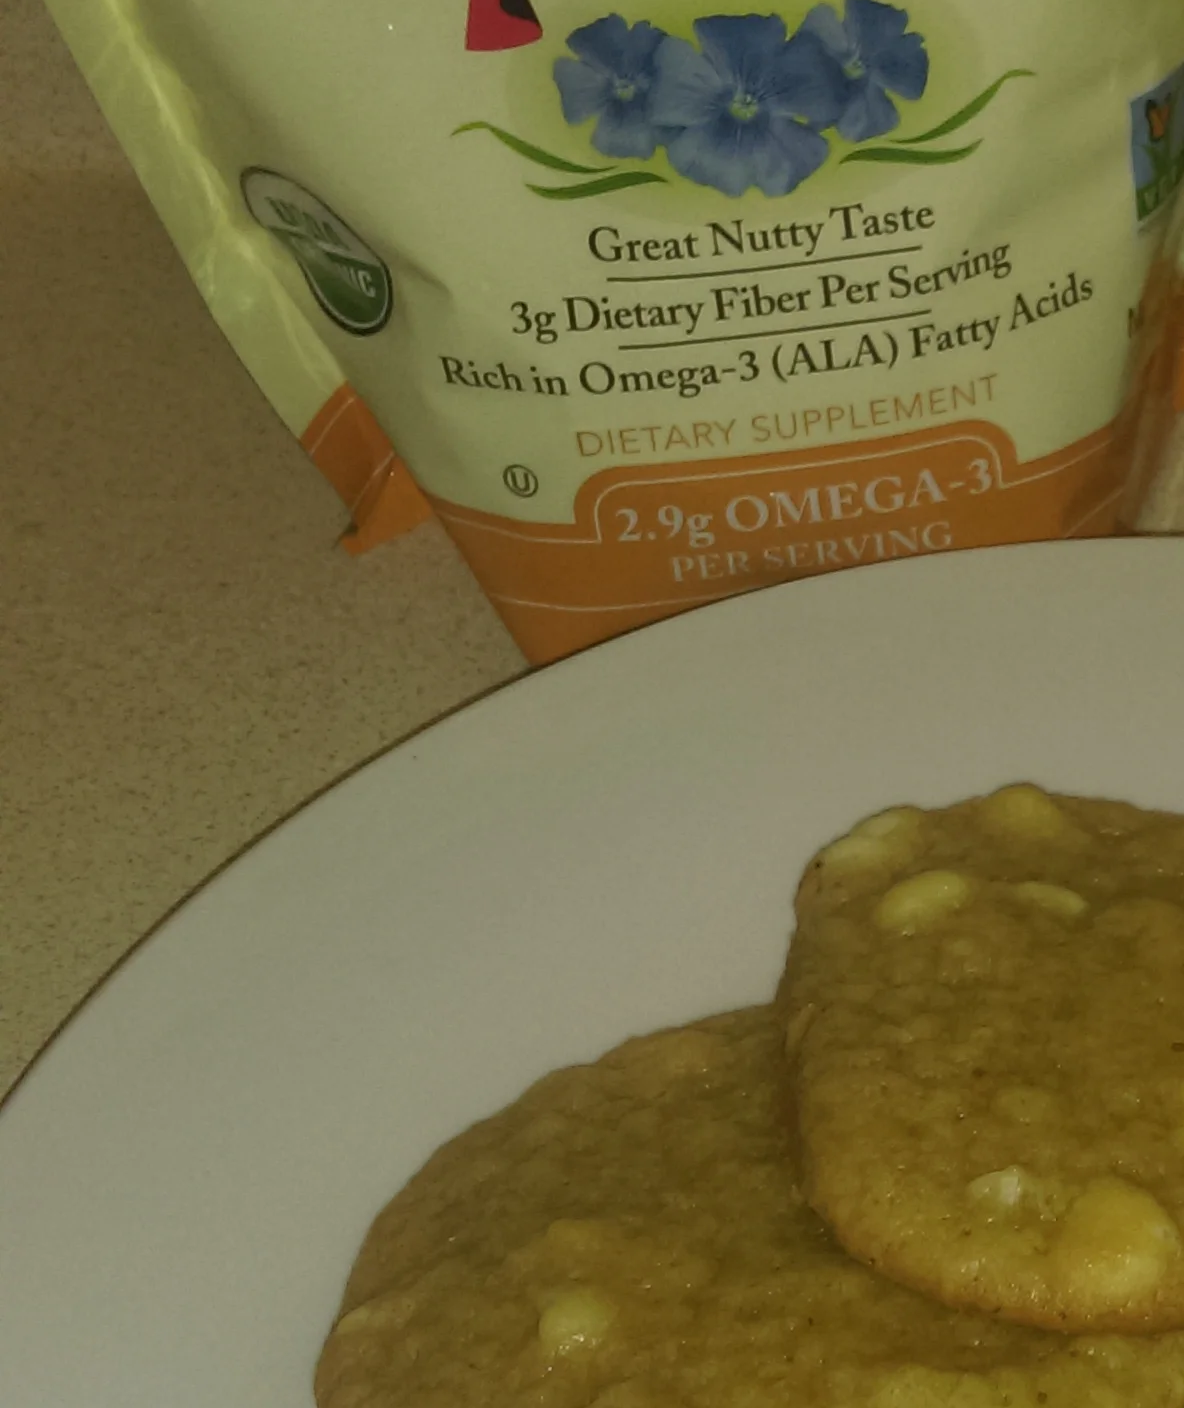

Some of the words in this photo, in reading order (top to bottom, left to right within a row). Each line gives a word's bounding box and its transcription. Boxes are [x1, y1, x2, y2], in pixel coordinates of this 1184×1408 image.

[588, 225, 698, 263] Great
[710, 219, 825, 259] Nutty
[829, 202, 936, 243] Taste
[438, 355, 523, 393] Rich
[530, 366, 570, 397] in
[579, 351, 760, 398] Omega-3
[771, 331, 900, 383] (ALA)
[909, 316, 1001, 359] Fatty
[1007, 272, 1094, 333] Acids
[509, 300, 557, 345] 3g
[563, 296, 704, 337] Dietary
[712, 281, 814, 324] Fiber
[819, 272, 878, 311] Per
[887, 242, 1013, 301] Serving
[575, 417, 738, 459] DIETARY
[751, 373, 999, 443] SUPPLEMENT
[615, 504, 716, 549] 2.9g
[725, 457, 992, 534] OMEGA-3
[669, 550, 750, 583] PER
[763, 520, 954, 570] SERVING
